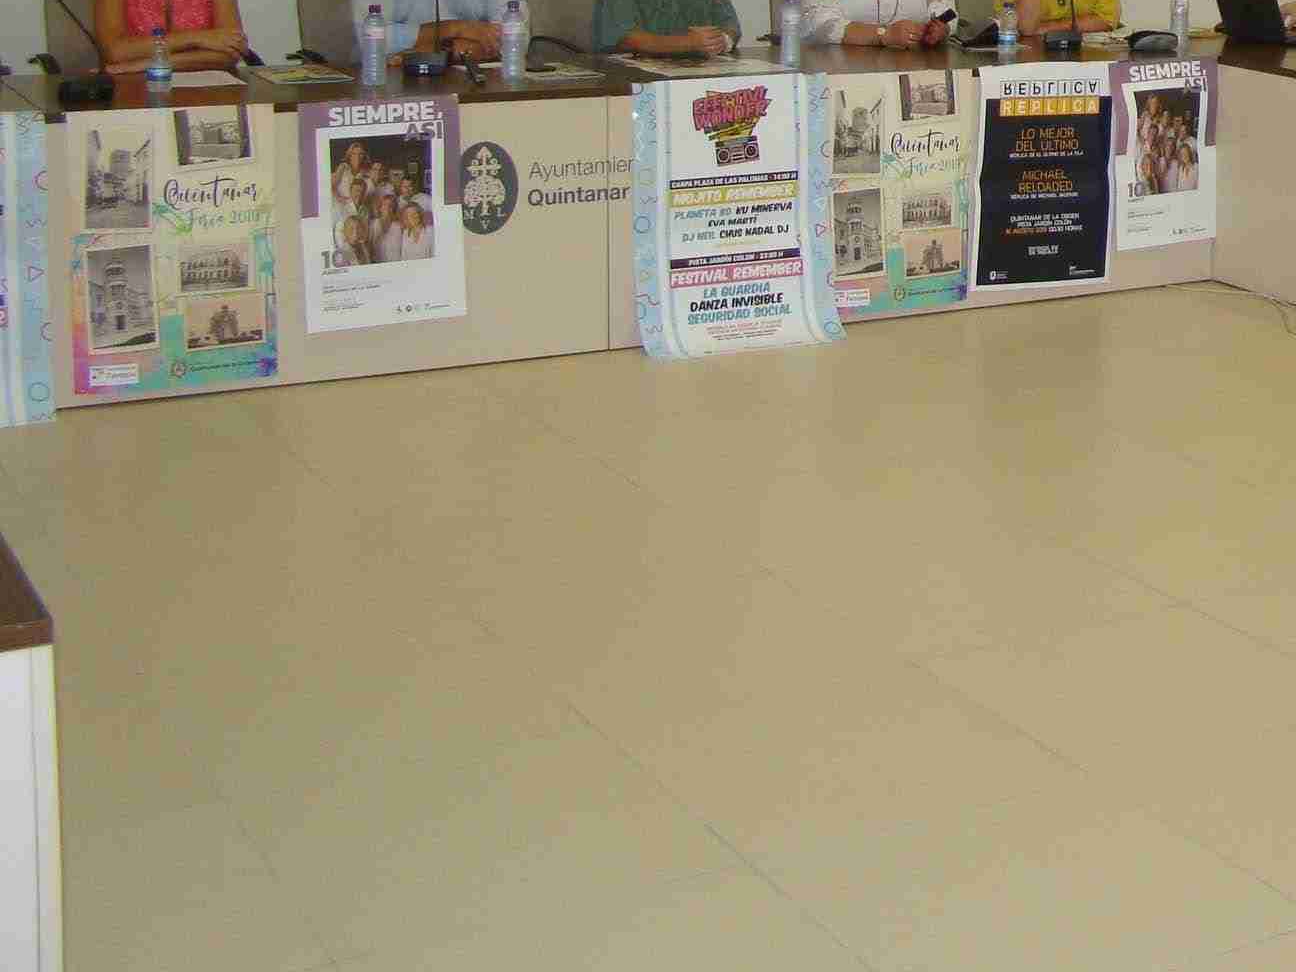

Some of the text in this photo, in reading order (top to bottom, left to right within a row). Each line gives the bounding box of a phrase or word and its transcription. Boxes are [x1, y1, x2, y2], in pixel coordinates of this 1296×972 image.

[527, 186, 631, 206] Quintanar
[751, 202, 792, 214] MINERVA
[672, 261, 802, 287] FESTIVAL REMEMBER
[703, 282, 770, 299] LA GUARDIA
[690, 292, 783, 312] DANZA INVISIBLE
[688, 303, 793, 325] SEGURIDAD SOCIAL
